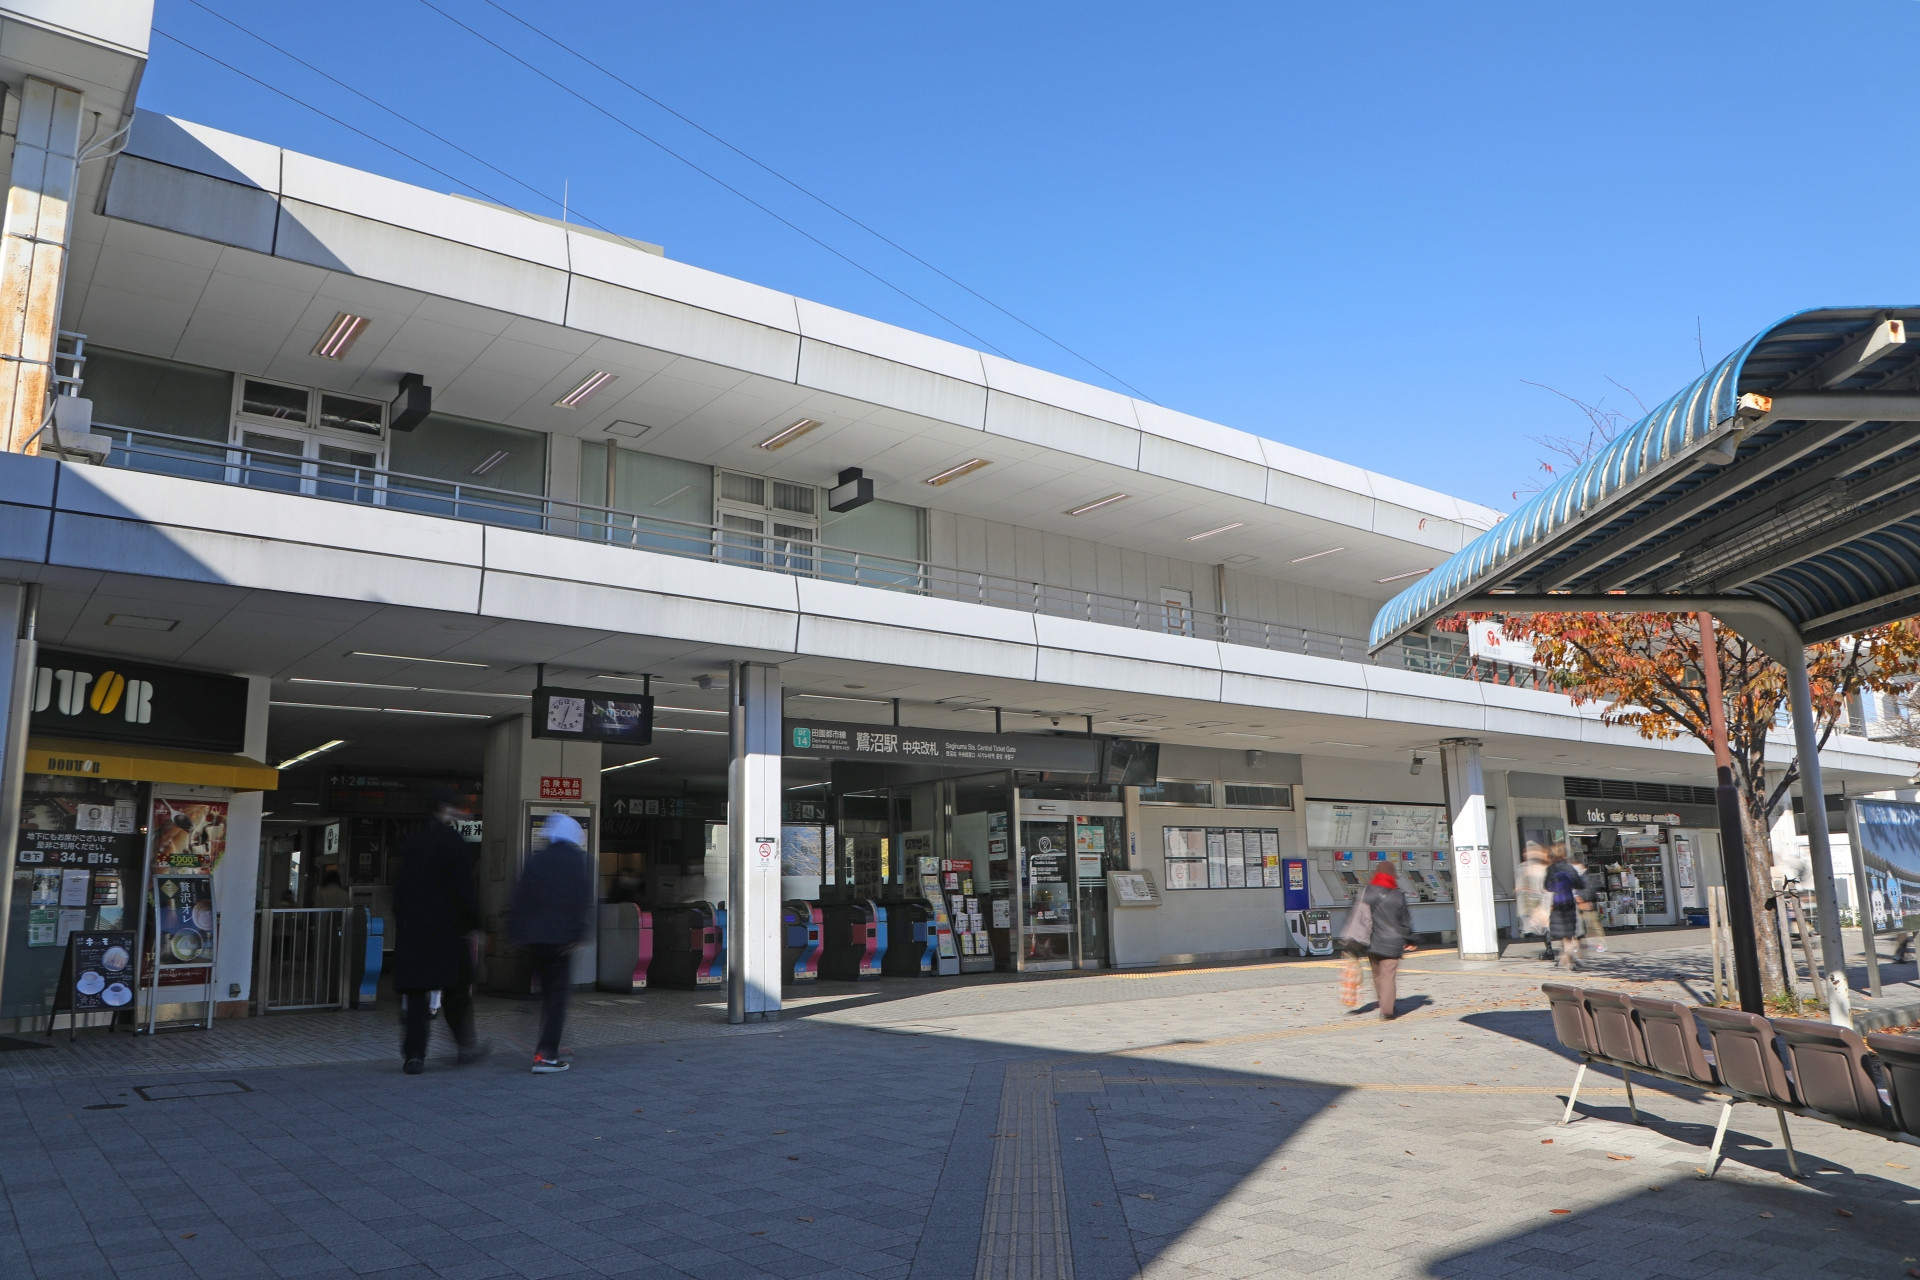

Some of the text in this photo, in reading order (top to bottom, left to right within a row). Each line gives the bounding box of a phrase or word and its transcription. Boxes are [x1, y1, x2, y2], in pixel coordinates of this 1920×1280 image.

[811, 728, 847, 739] 田園都市線
[797, 737, 808, 746] 14
[856, 732, 939, 756] 鷺沼駅 中央改札
[945, 742, 967, 750] Saginuma
[48, 758, 101, 773] DOUTOR
[543, 779, 580, 789] 危険物品
[1587, 808, 1606, 822] toks
[26, 832, 117, 844] 地下にもお席がございます。
[36, 841, 106, 851] 是非ご利用ください。
[179, 881, 193, 923] 贅沢オレ
